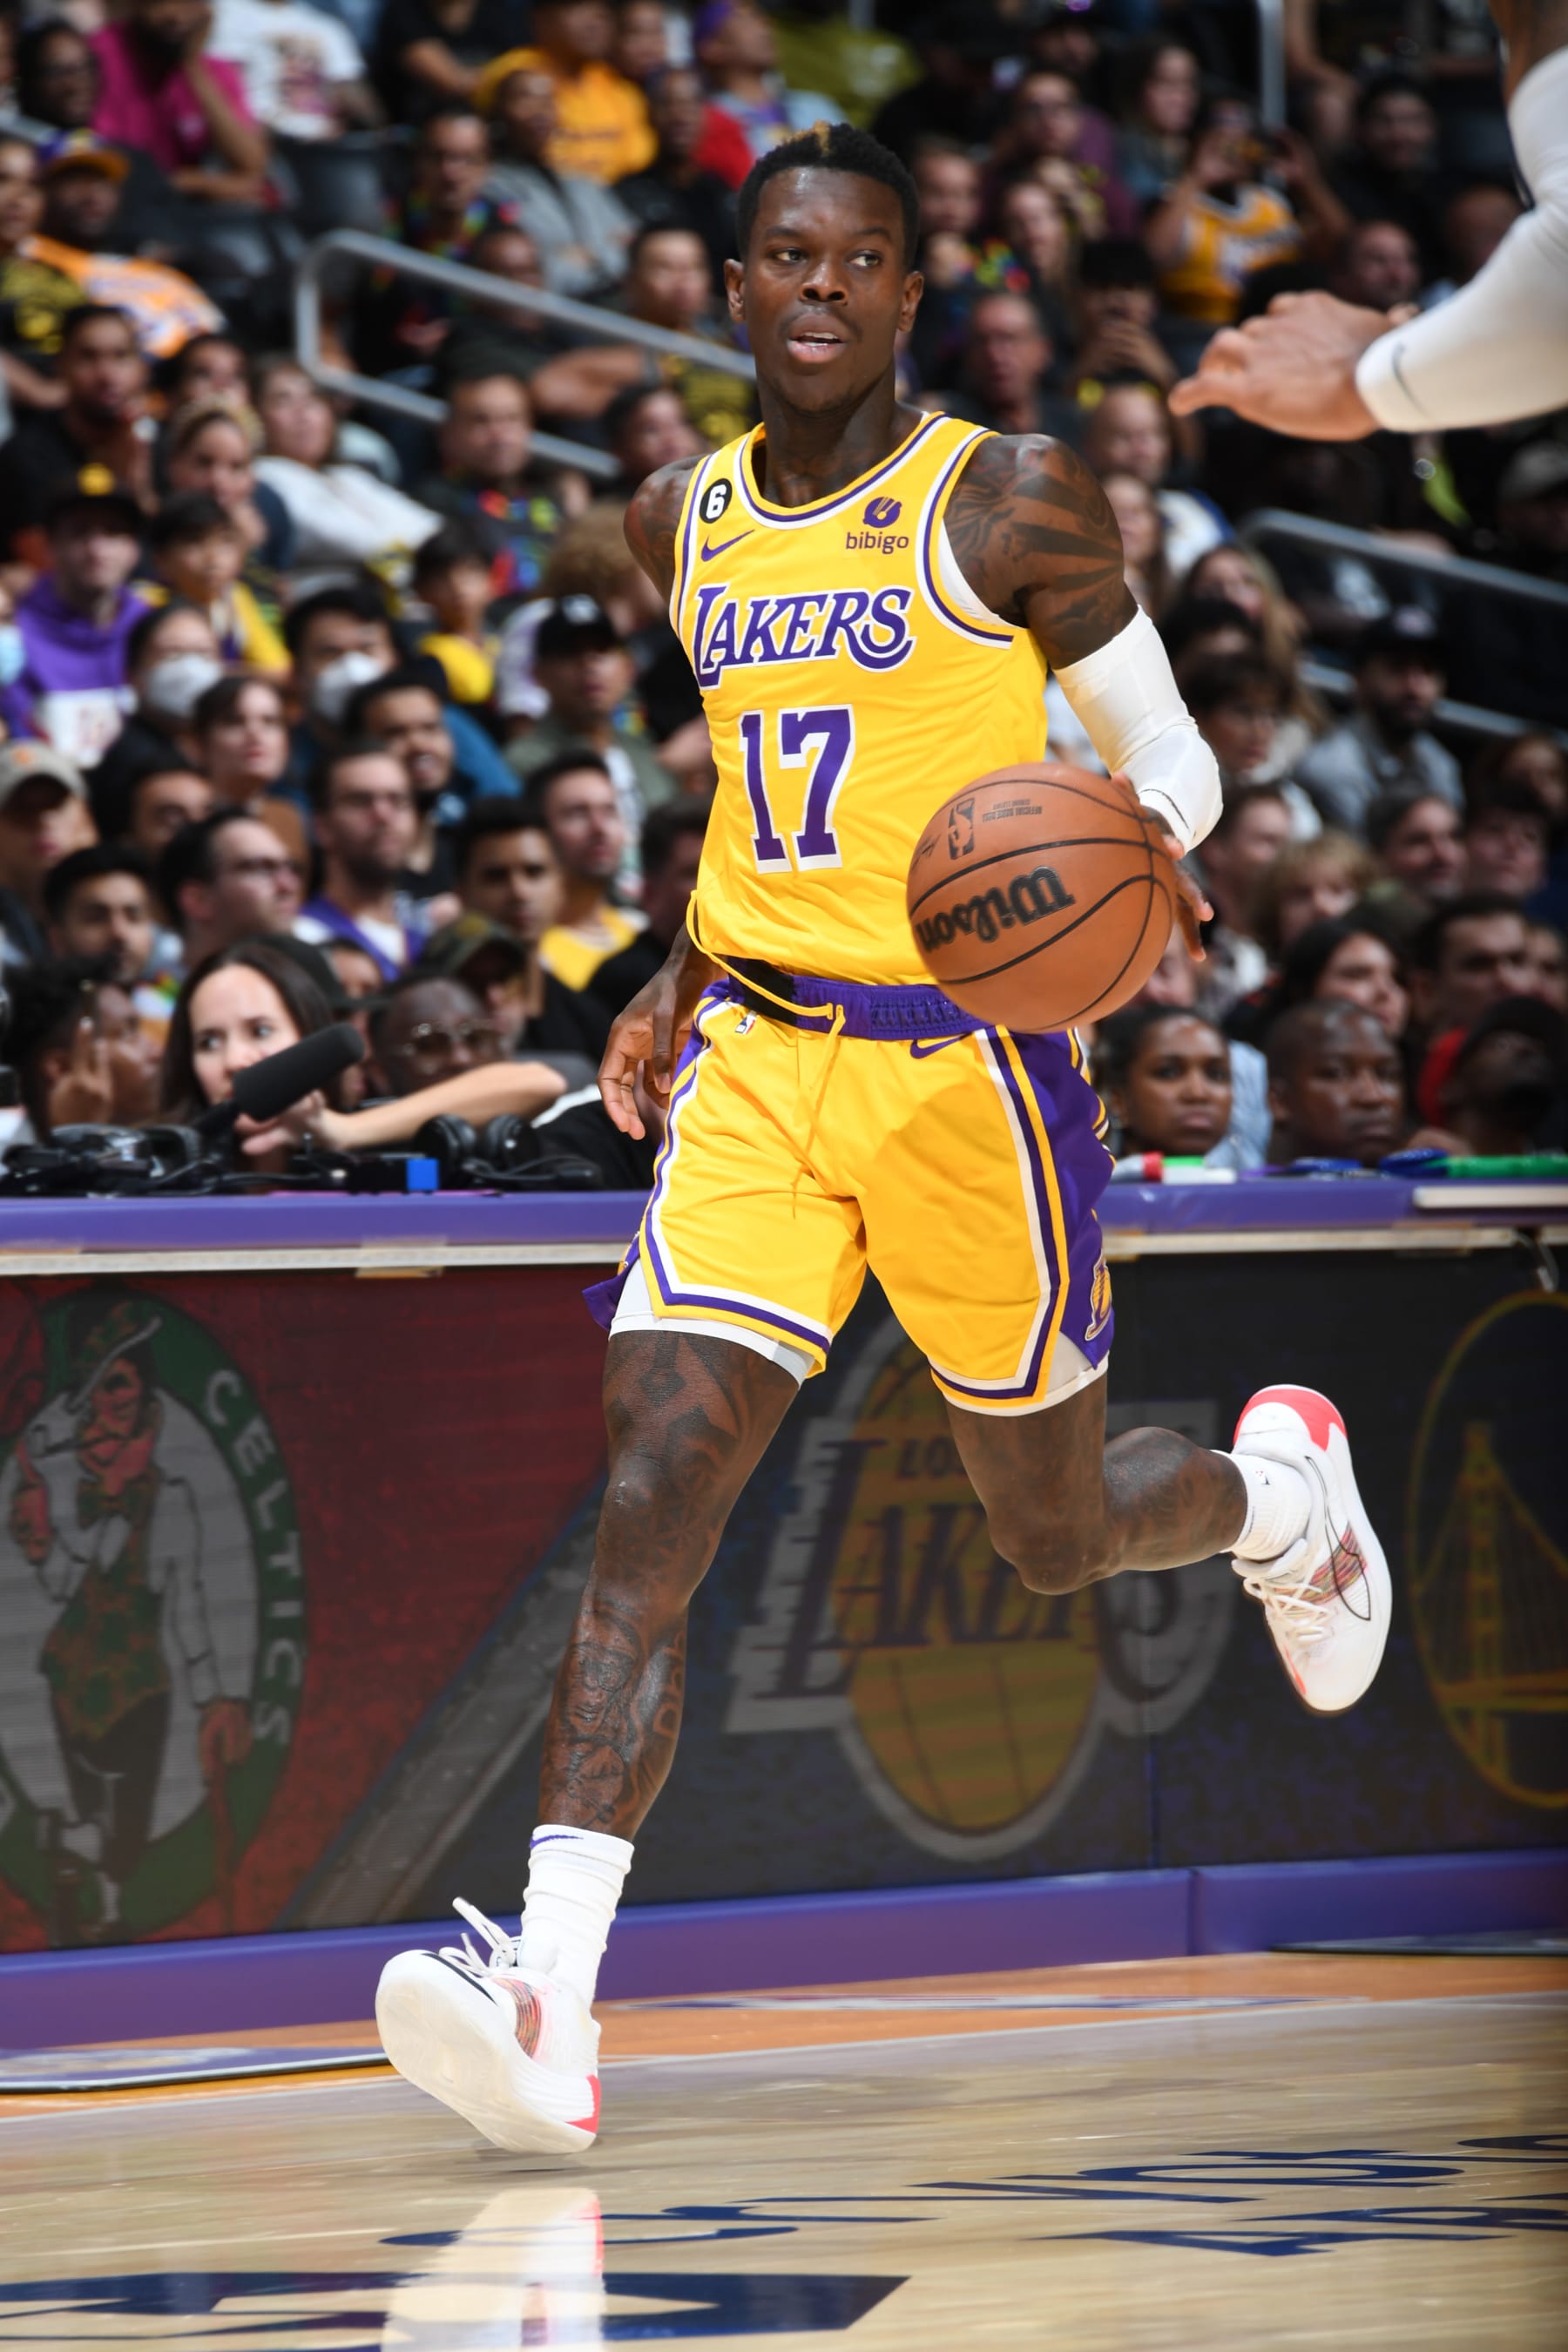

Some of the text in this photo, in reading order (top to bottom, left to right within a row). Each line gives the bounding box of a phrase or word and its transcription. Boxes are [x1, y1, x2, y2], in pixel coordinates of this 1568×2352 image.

[706, 483, 727, 520] 6
[845, 531, 910, 555] bibigo
[694, 584, 916, 690] LAKERS
[738, 703, 856, 874] 17
[916, 866, 1077, 954] Wilson
[896, 1435, 968, 1479] LO
[203, 1369, 306, 1744] CELTICS
